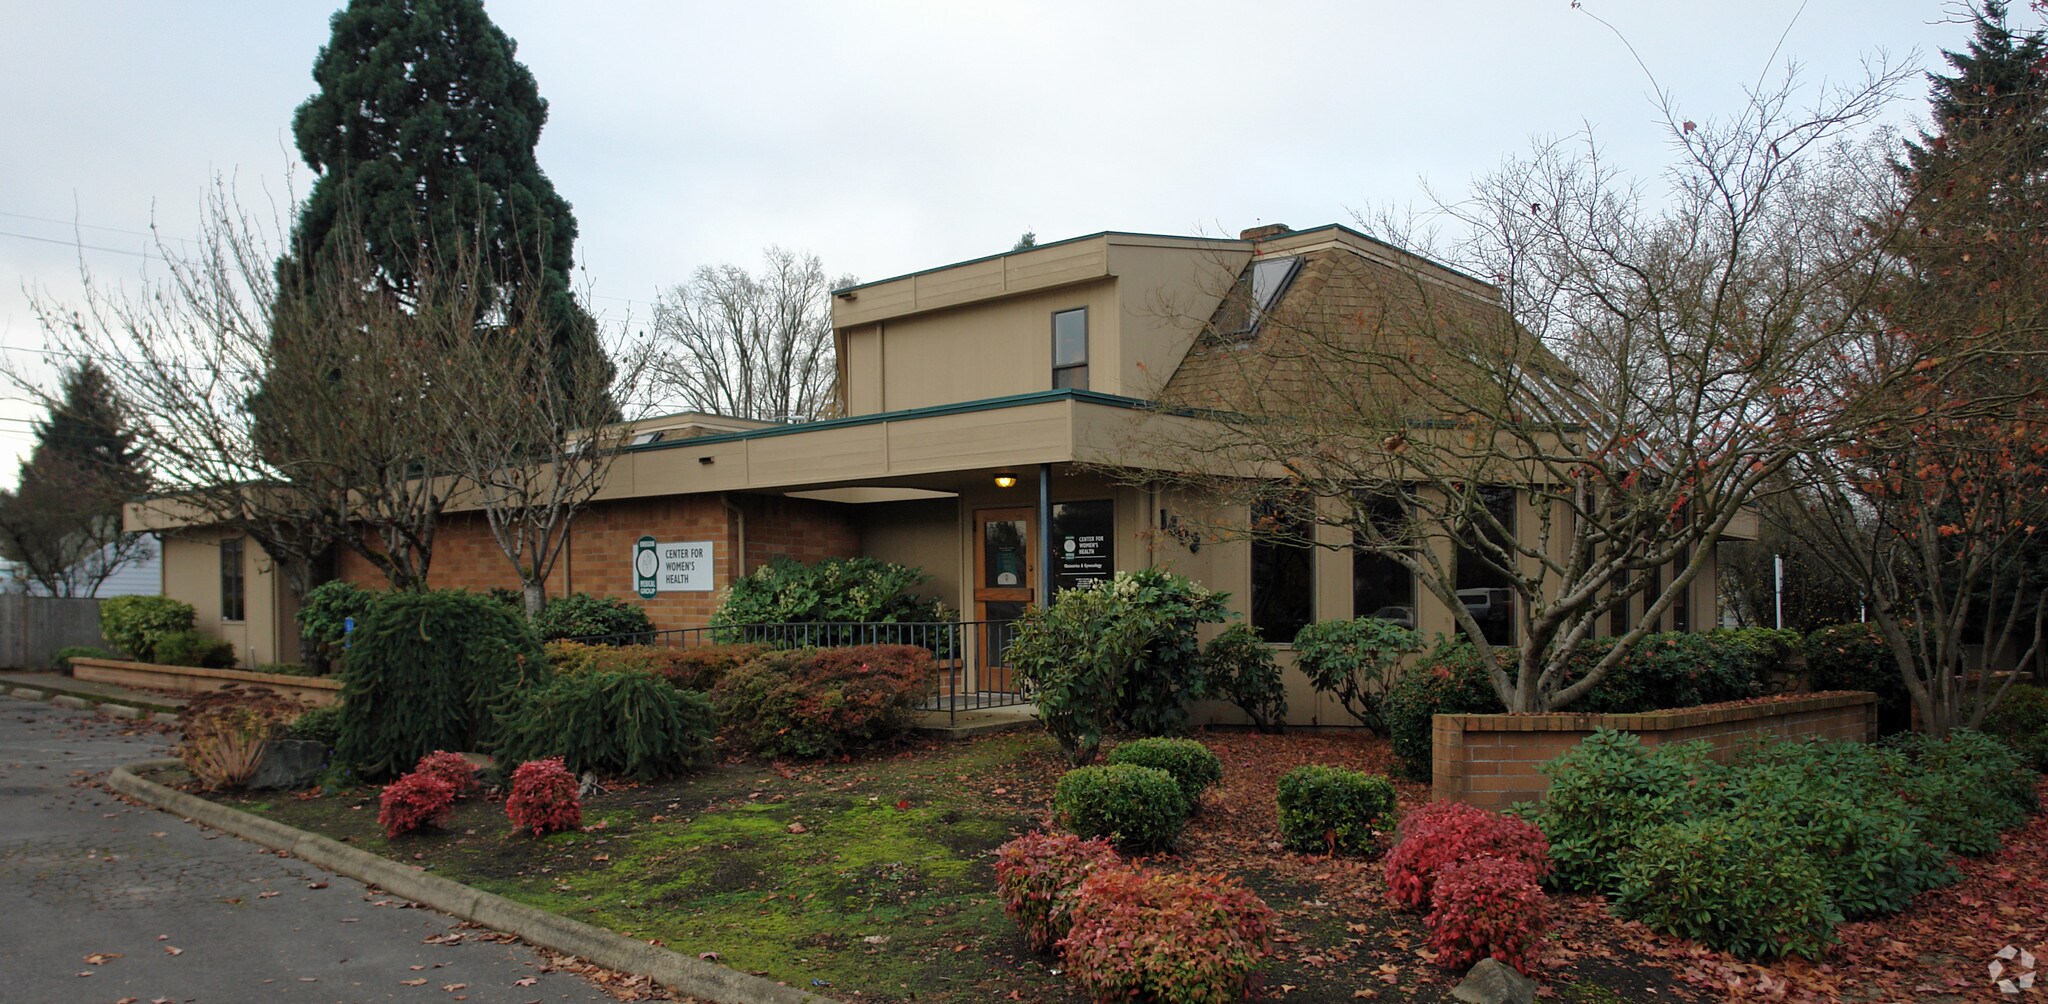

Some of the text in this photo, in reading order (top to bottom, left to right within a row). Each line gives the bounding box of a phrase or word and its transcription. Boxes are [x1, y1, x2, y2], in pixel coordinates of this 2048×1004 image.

[665, 548, 704, 558] CENTER FOR
[666, 562, 695, 571] WOMEN'S
[666, 574, 689, 584] HEALTH
